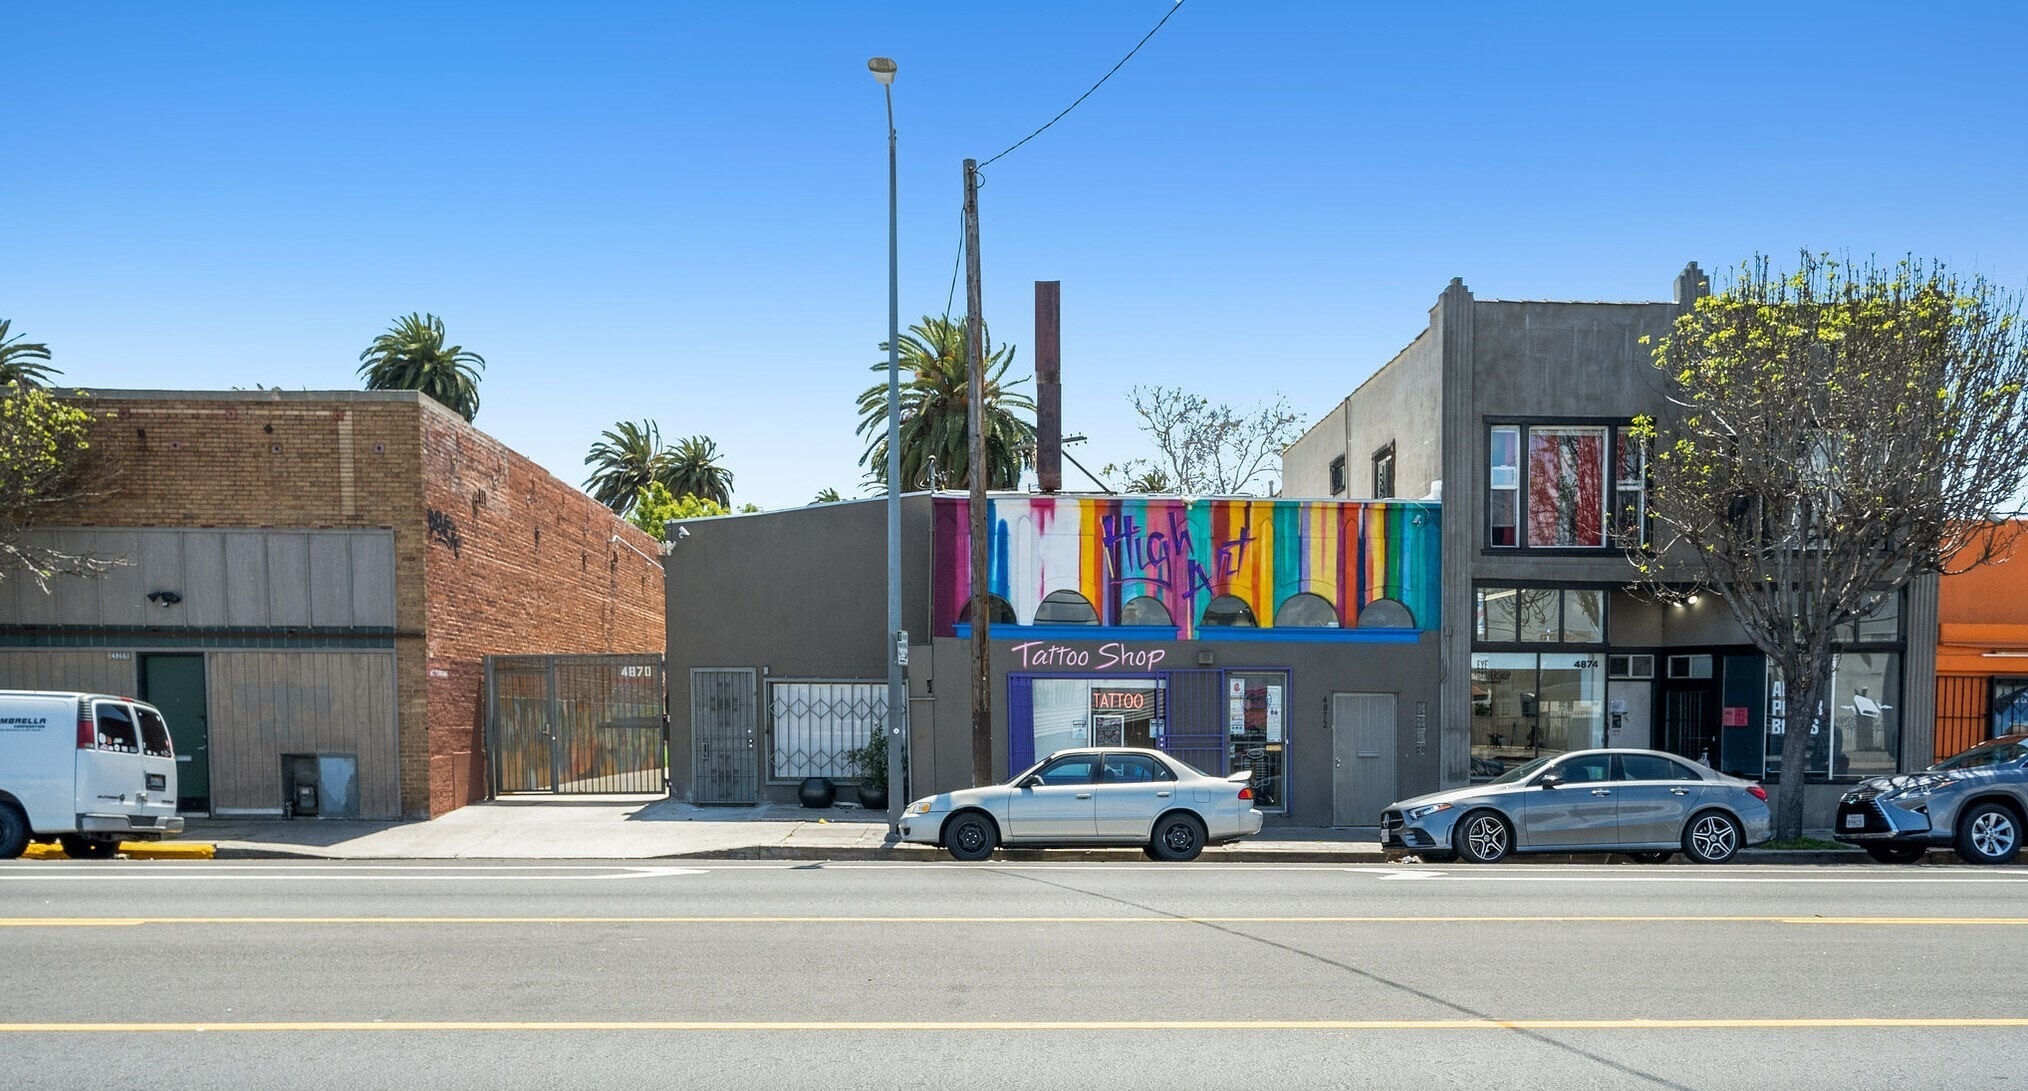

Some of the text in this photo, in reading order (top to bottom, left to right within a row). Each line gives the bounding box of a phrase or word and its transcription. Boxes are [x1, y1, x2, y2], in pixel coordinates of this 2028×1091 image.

[1101, 512, 1195, 591] High
[1182, 527, 1257, 600] Art
[1011, 640, 1166, 672] Tattoo Shop
[1574, 660, 1598, 669] 4874
[621, 665, 652, 677] 4870
[1093, 692, 1144, 709] TATTOO
